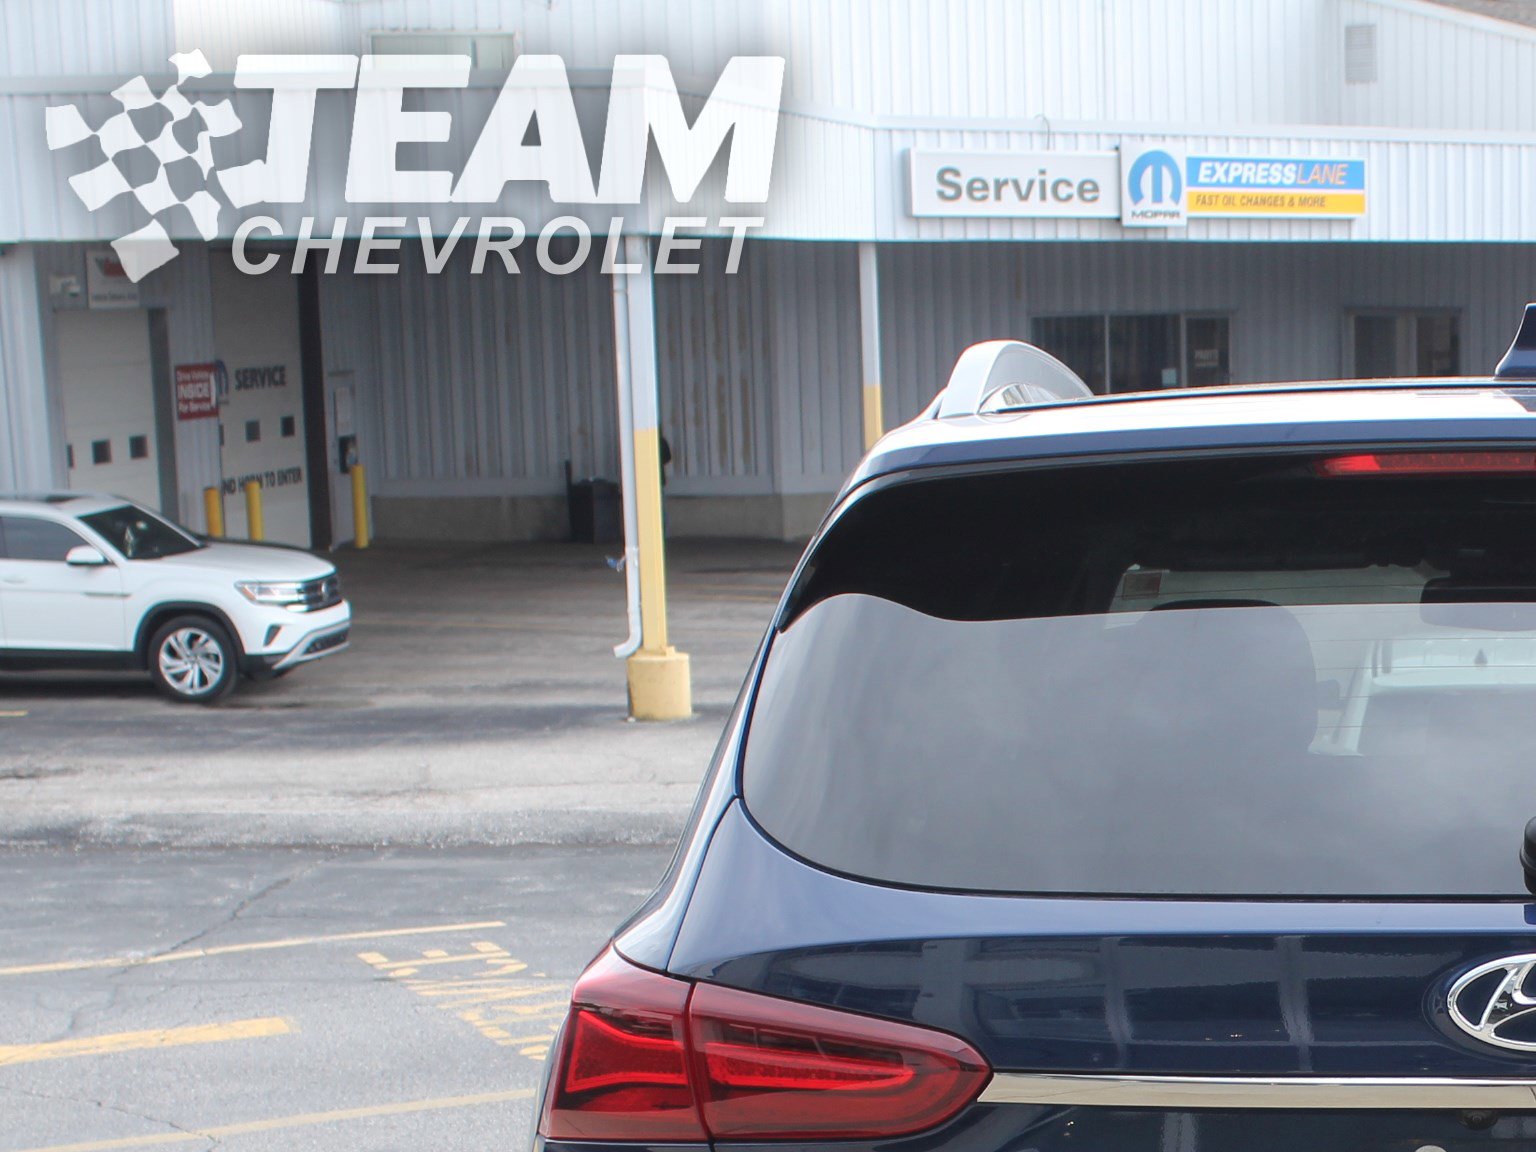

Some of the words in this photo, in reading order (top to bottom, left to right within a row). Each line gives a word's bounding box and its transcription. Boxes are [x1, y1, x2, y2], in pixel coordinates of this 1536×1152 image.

[936, 165, 1100, 202] Service
[1195, 194, 1218, 207] FAST
[1221, 194, 1237, 207] OIL
[1239, 195, 1285, 208] CHANGES
[1287, 196, 1295, 207] &
[1298, 196, 1326, 208] MORE
[1131, 210, 1180, 219] MOPAR
[235, 365, 286, 391] SERVICE
[264, 471, 275, 487] TO
[278, 467, 302, 486] ENTER
